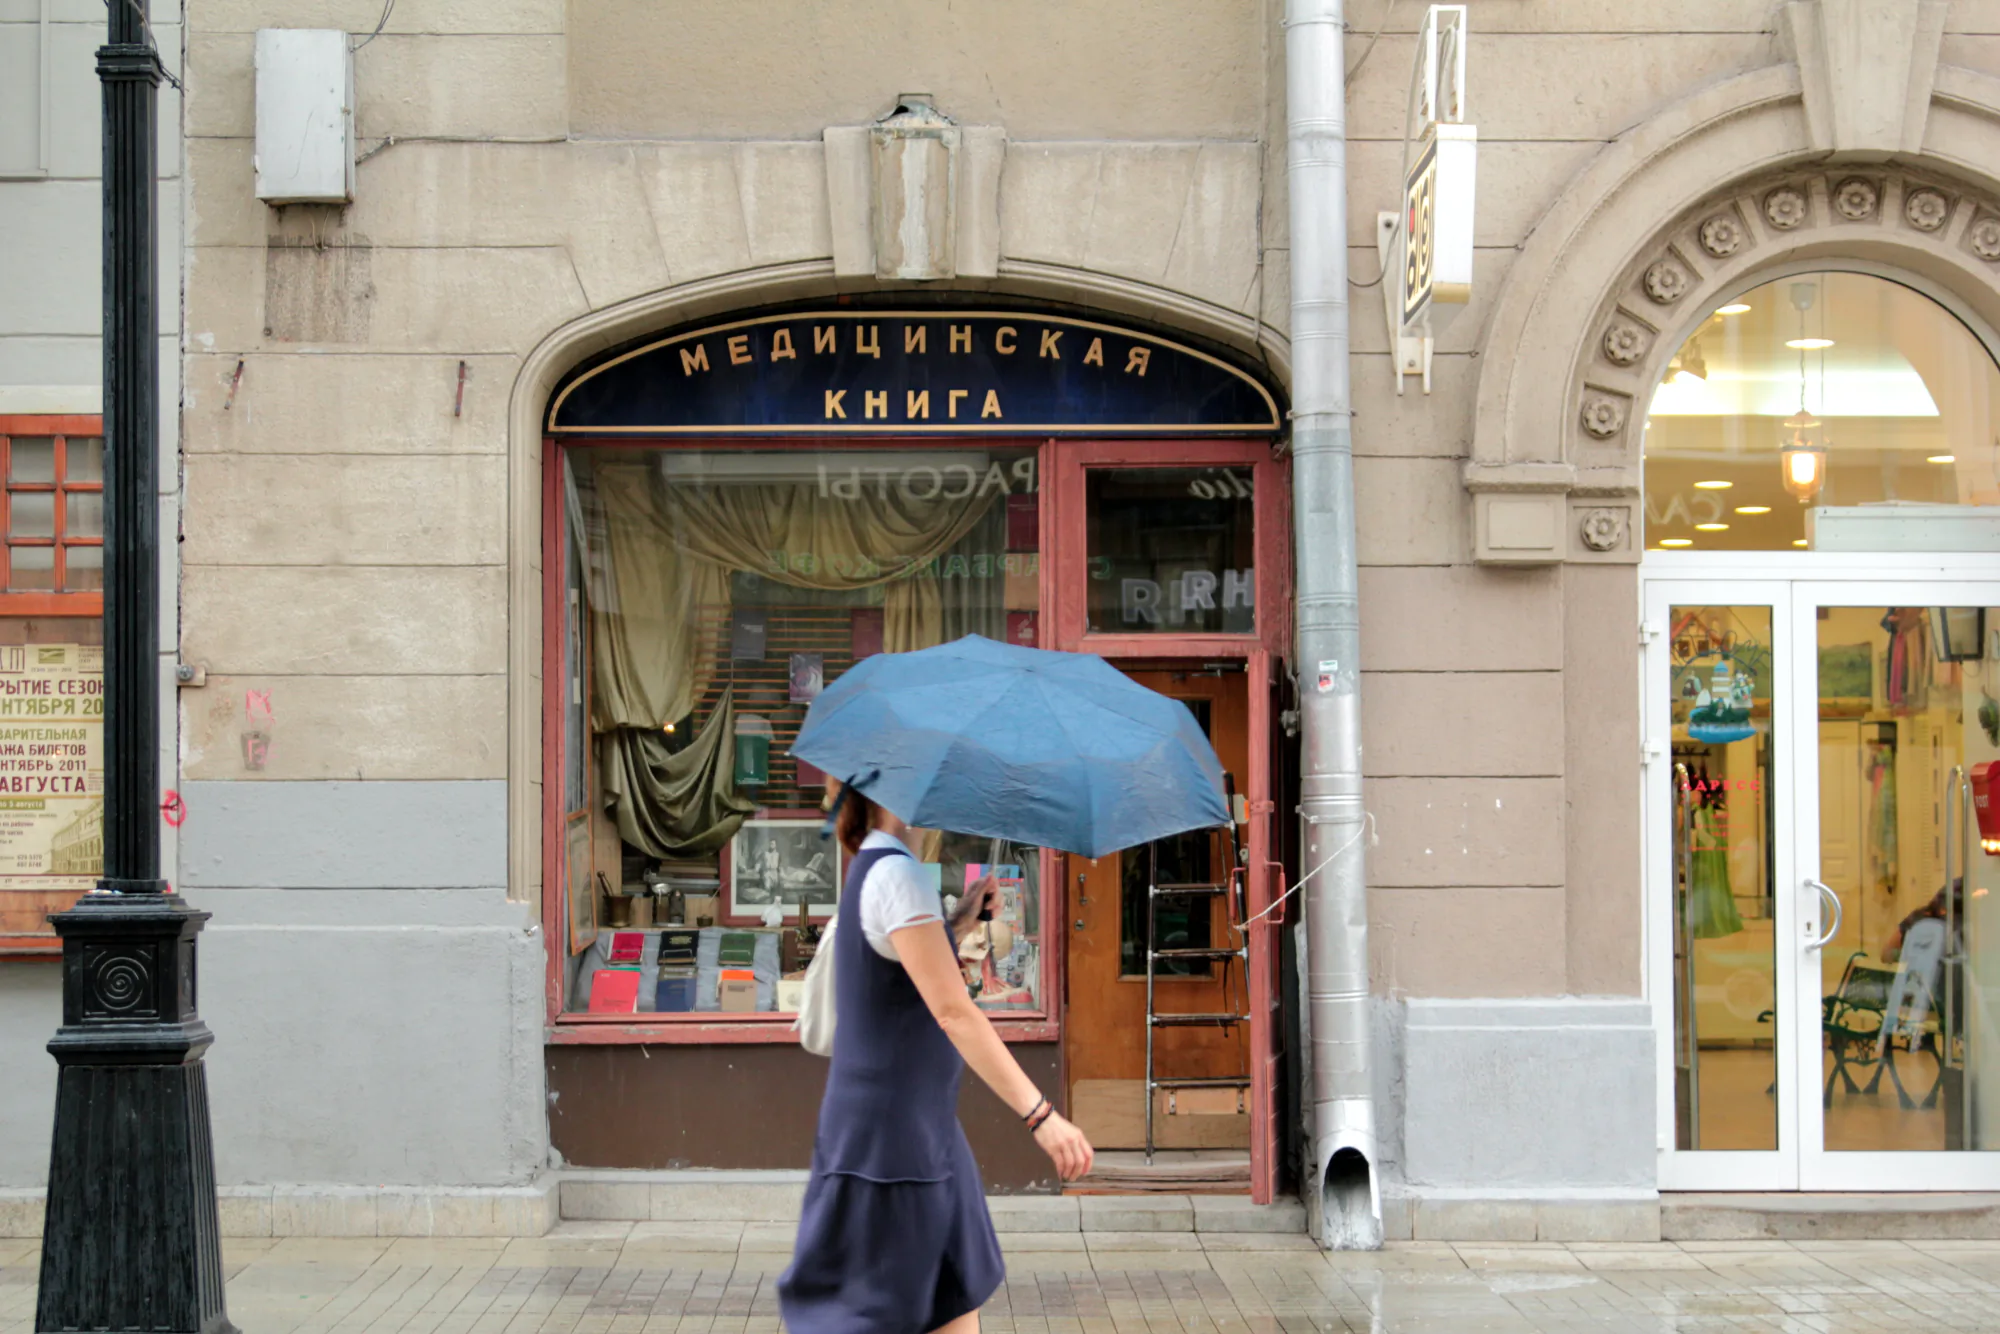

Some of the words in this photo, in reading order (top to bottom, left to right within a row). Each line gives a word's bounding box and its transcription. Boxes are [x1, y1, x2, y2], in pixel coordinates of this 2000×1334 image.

[680, 325, 1151, 376] МЕДИЦИНСКАЯ
[825, 390, 1003, 419] КНИГА
[29, 744, 86, 756] БИЛЕТОВ
[59, 760, 86, 771] 2011
[0, 776, 86, 792] АВГУСТА
